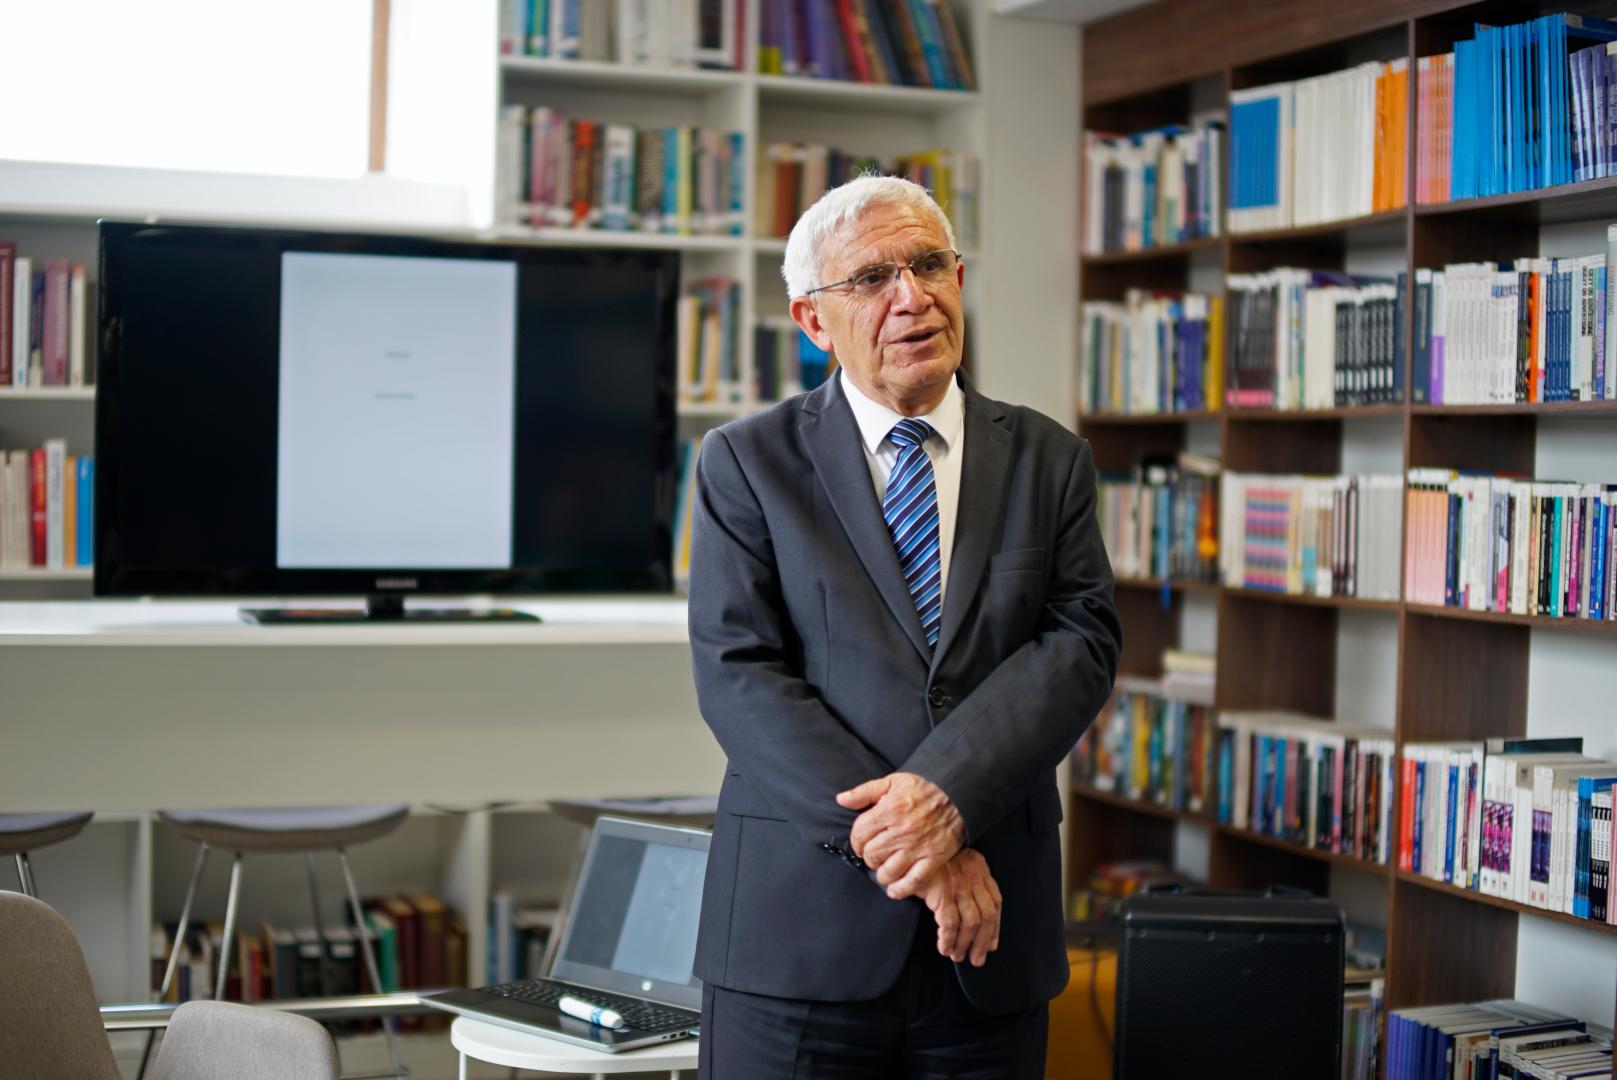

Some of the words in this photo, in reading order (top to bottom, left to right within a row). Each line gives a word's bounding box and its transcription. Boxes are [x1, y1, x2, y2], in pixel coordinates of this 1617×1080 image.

[1597, 289, 1605, 320] MEDIA
[1607, 265, 1615, 316] ADVERTISING
[1596, 323, 1604, 378] INDUSTRIES
